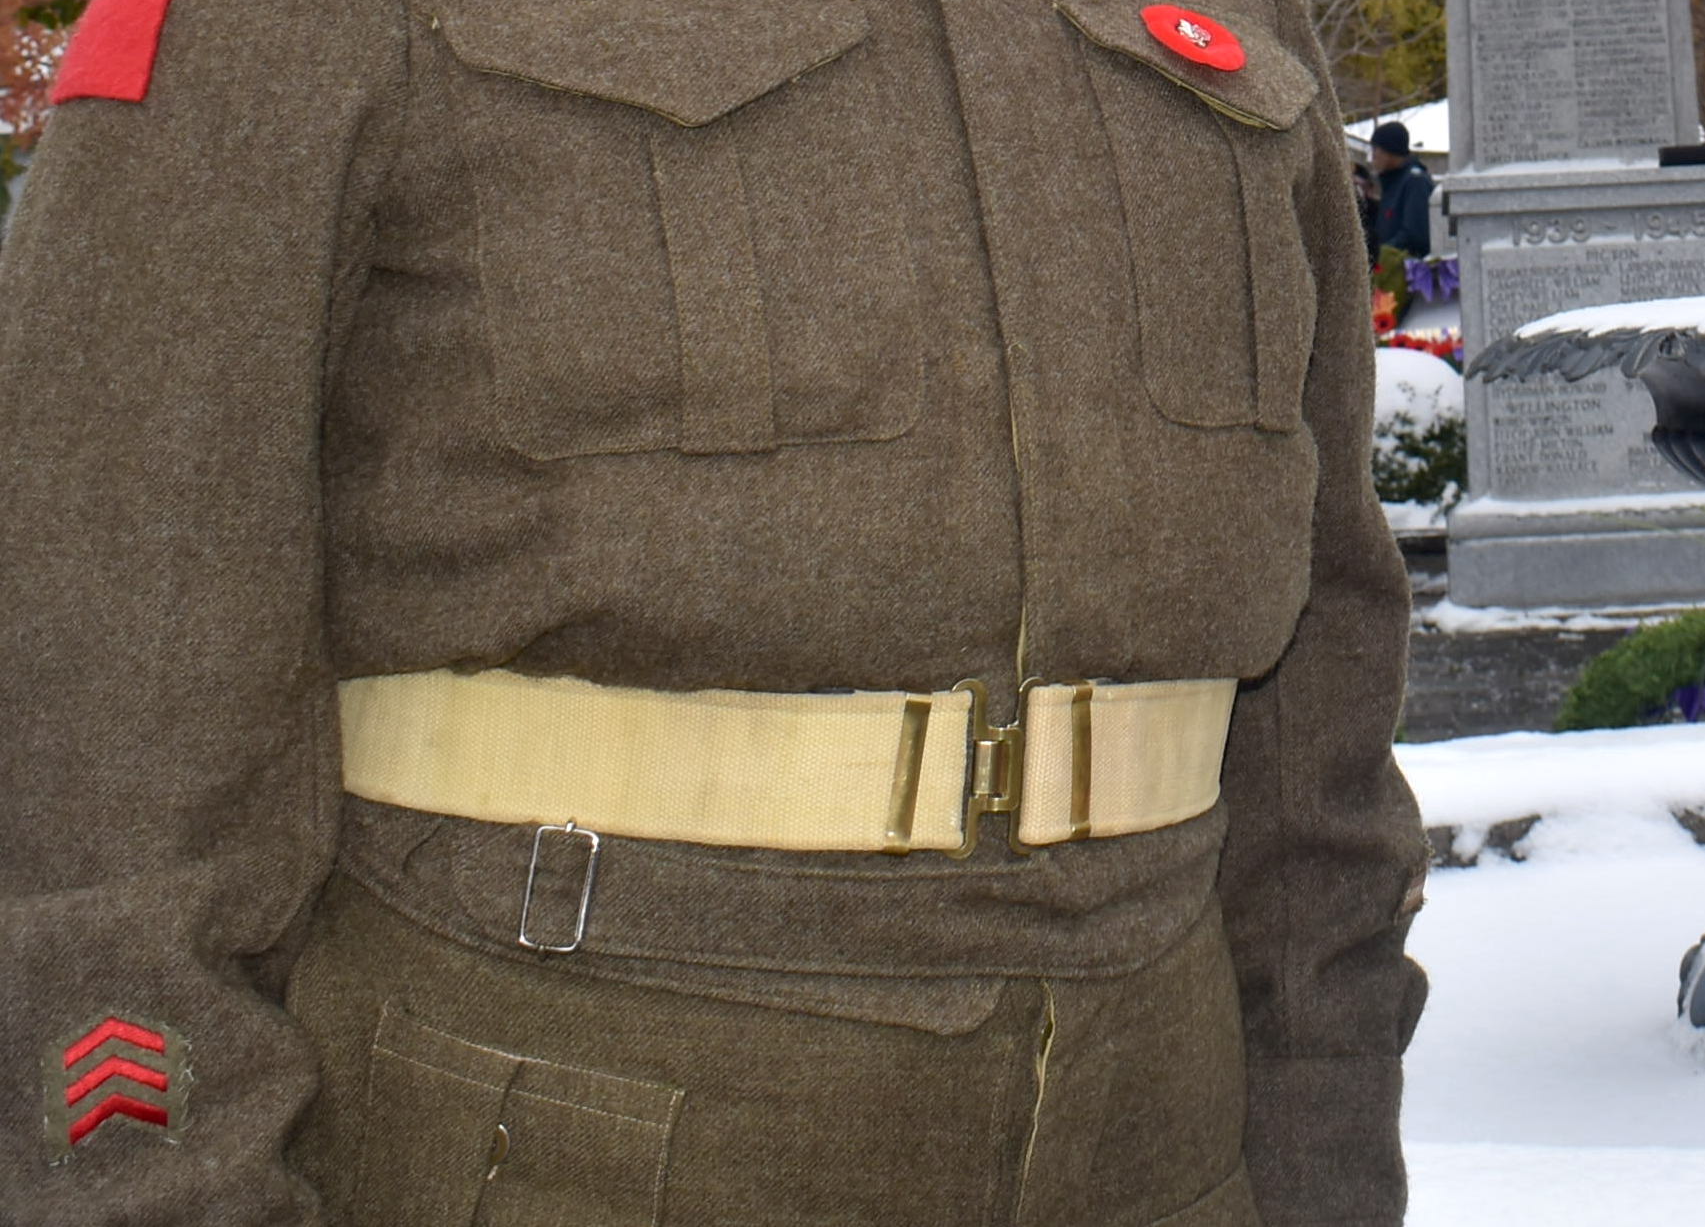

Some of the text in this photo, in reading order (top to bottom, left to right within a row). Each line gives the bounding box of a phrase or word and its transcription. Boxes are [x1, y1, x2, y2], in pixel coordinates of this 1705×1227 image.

[1511, 216, 1591, 247] 1939
[1586, 249, 1640, 262] PICTON
[1505, 399, 1601, 414] WELLINGTON
